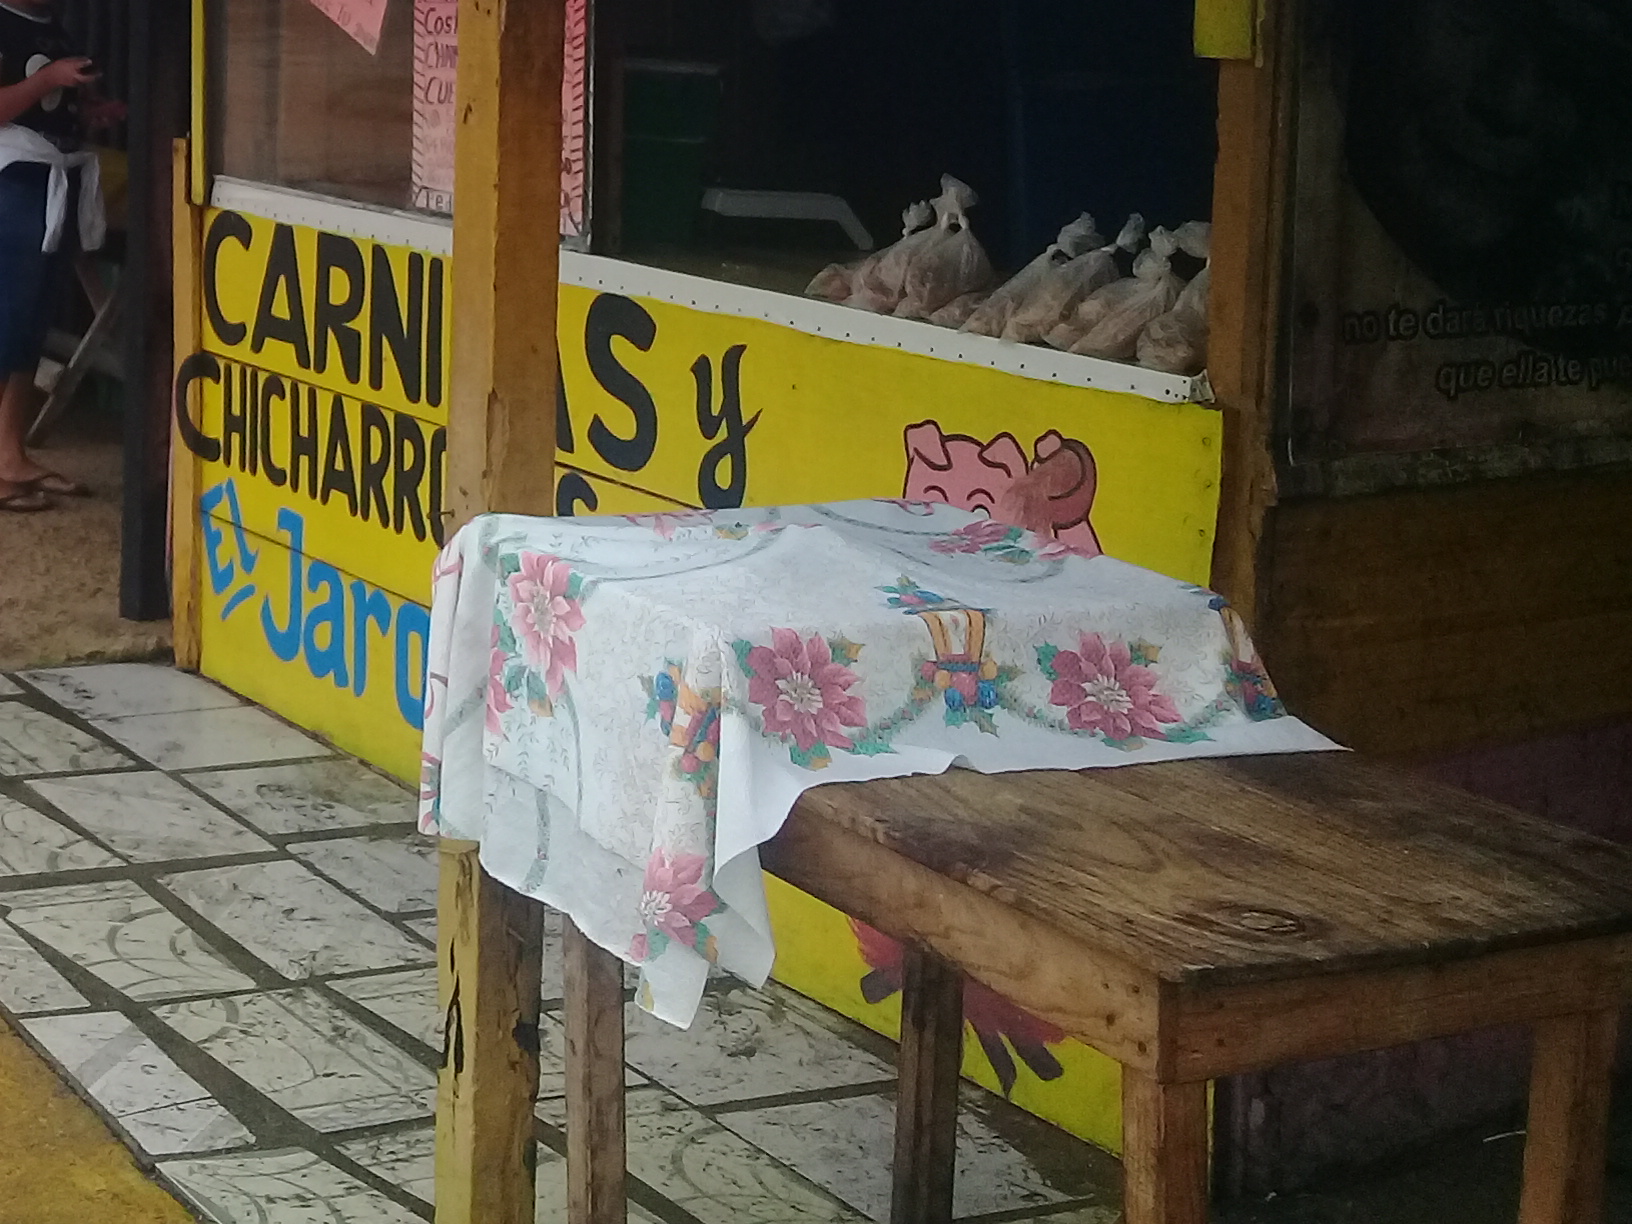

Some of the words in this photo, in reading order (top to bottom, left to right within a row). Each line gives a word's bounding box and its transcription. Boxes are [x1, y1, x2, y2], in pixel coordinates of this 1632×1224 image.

[204, 209, 657, 472] CARNIS
[1387, 307, 1418, 338] te
[1437, 363, 1495, 398] que
[260, 506, 431, 731] Jaro
